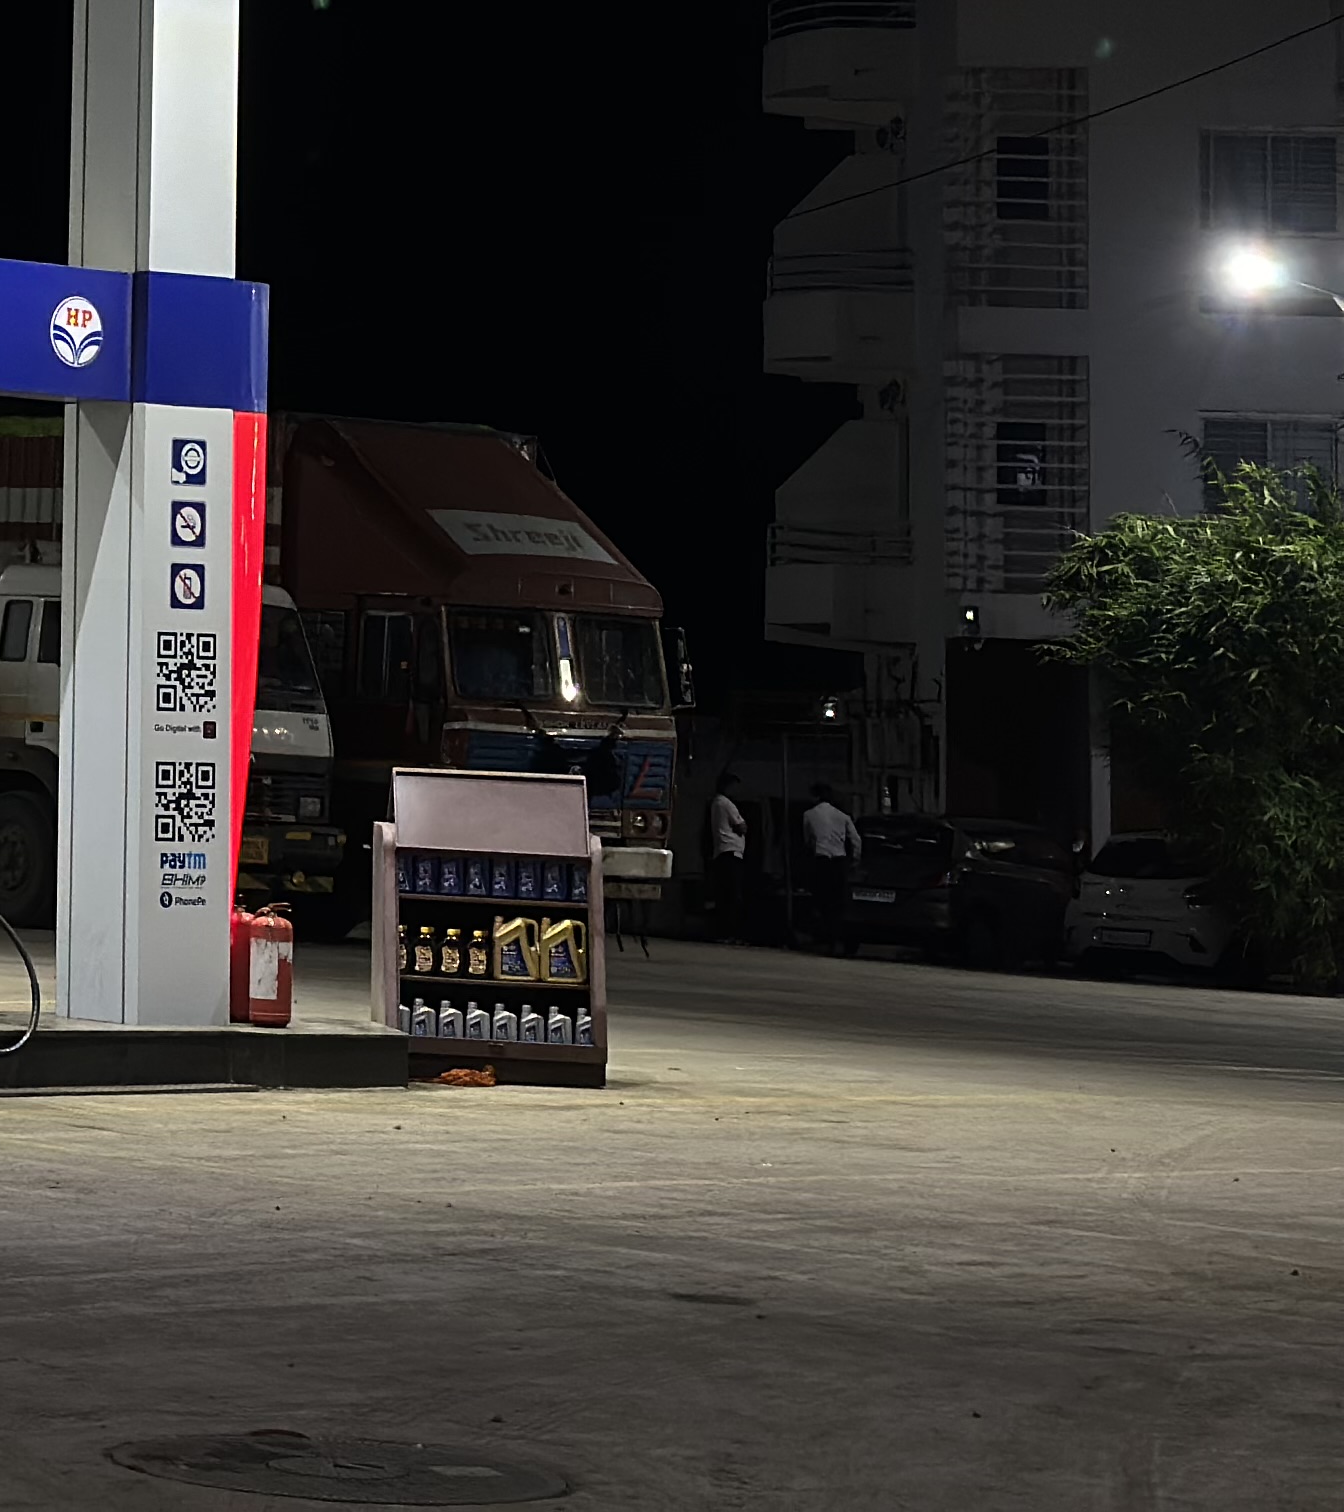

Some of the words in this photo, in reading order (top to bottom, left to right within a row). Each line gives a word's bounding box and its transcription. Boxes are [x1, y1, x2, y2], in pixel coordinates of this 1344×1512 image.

[66, 307, 93, 328] HP
[166, 724, 187, 734] Digital
[160, 852, 206, 870] paytm
